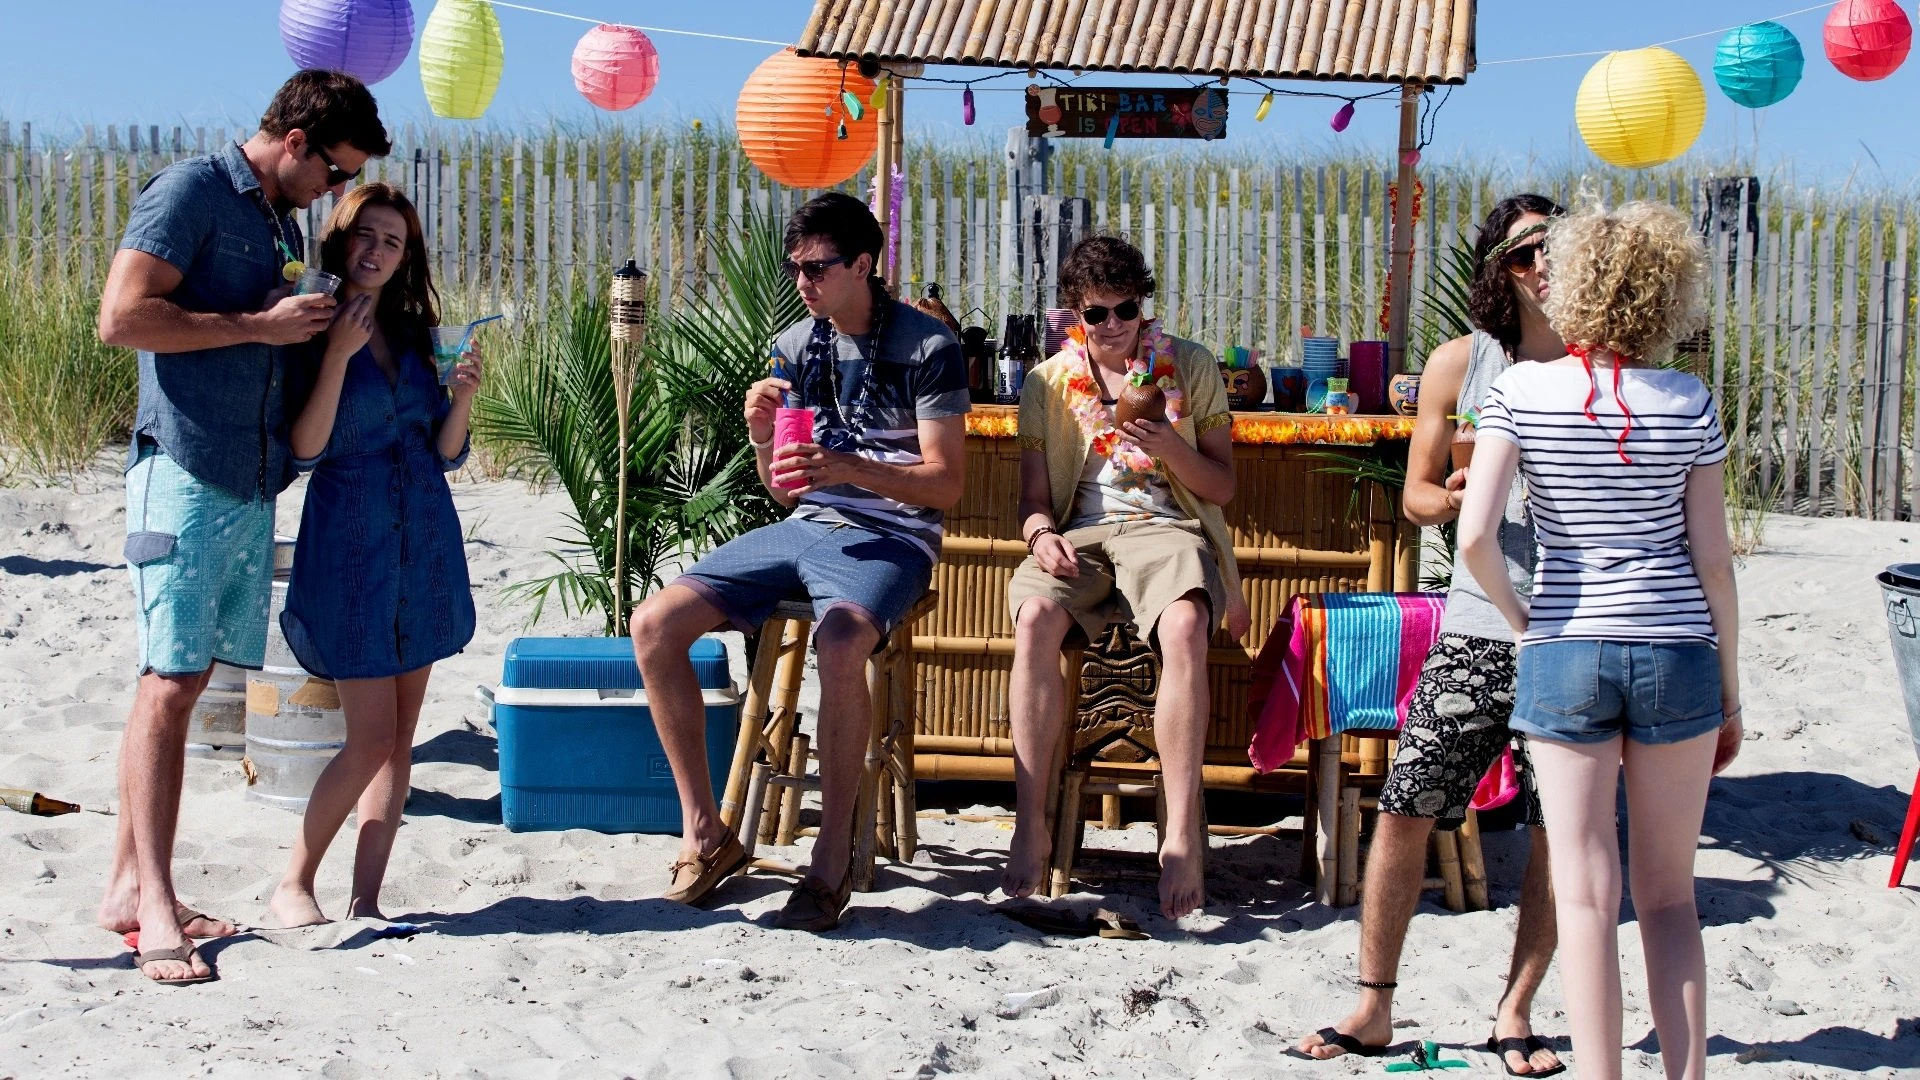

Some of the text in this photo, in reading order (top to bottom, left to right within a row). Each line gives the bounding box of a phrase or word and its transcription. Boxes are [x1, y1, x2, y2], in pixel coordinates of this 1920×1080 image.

[1059, 93, 1167, 112] TIKI BAR
[1078, 117, 1096, 133] IS
